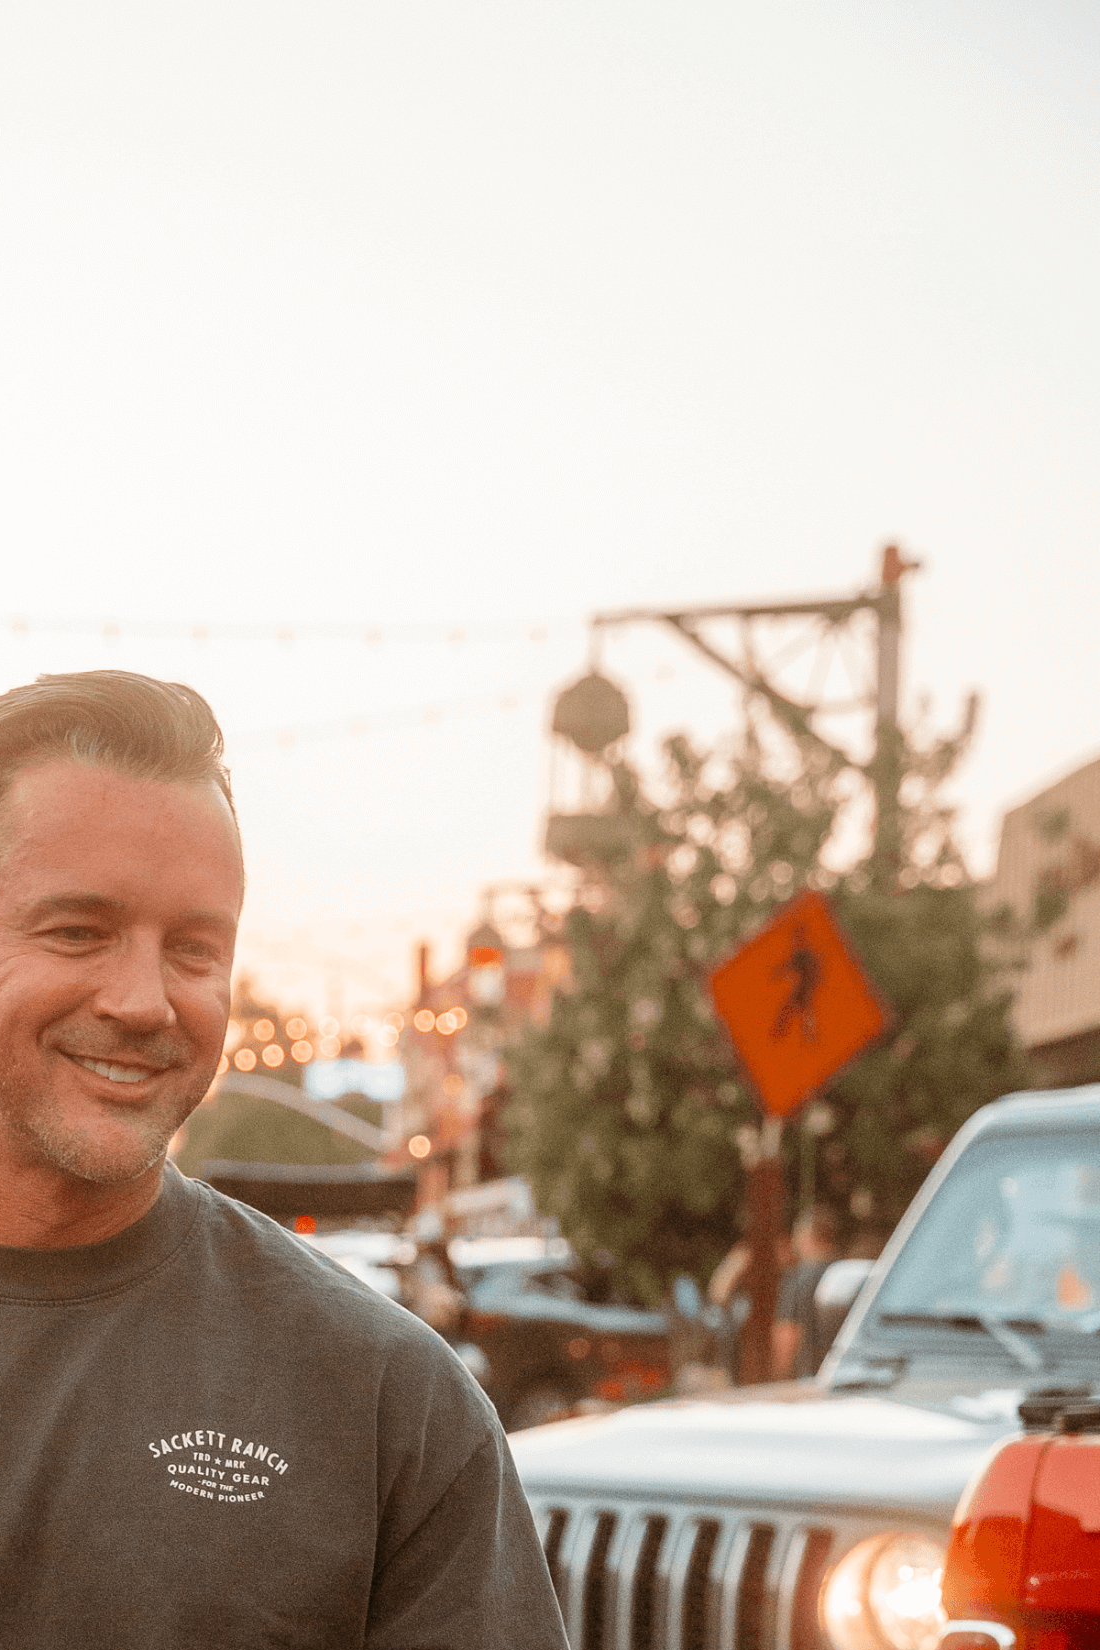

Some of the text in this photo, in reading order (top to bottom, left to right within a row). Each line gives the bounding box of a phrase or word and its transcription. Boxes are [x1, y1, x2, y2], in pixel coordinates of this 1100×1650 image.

[149, 1430, 289, 1476] SACKETT RANCH
[193, 1452, 246, 1469] TRD MRK
[167, 1464, 270, 1487] QUALITY GEAR
[169, 1479, 265, 1503] MODERN PIONEER
